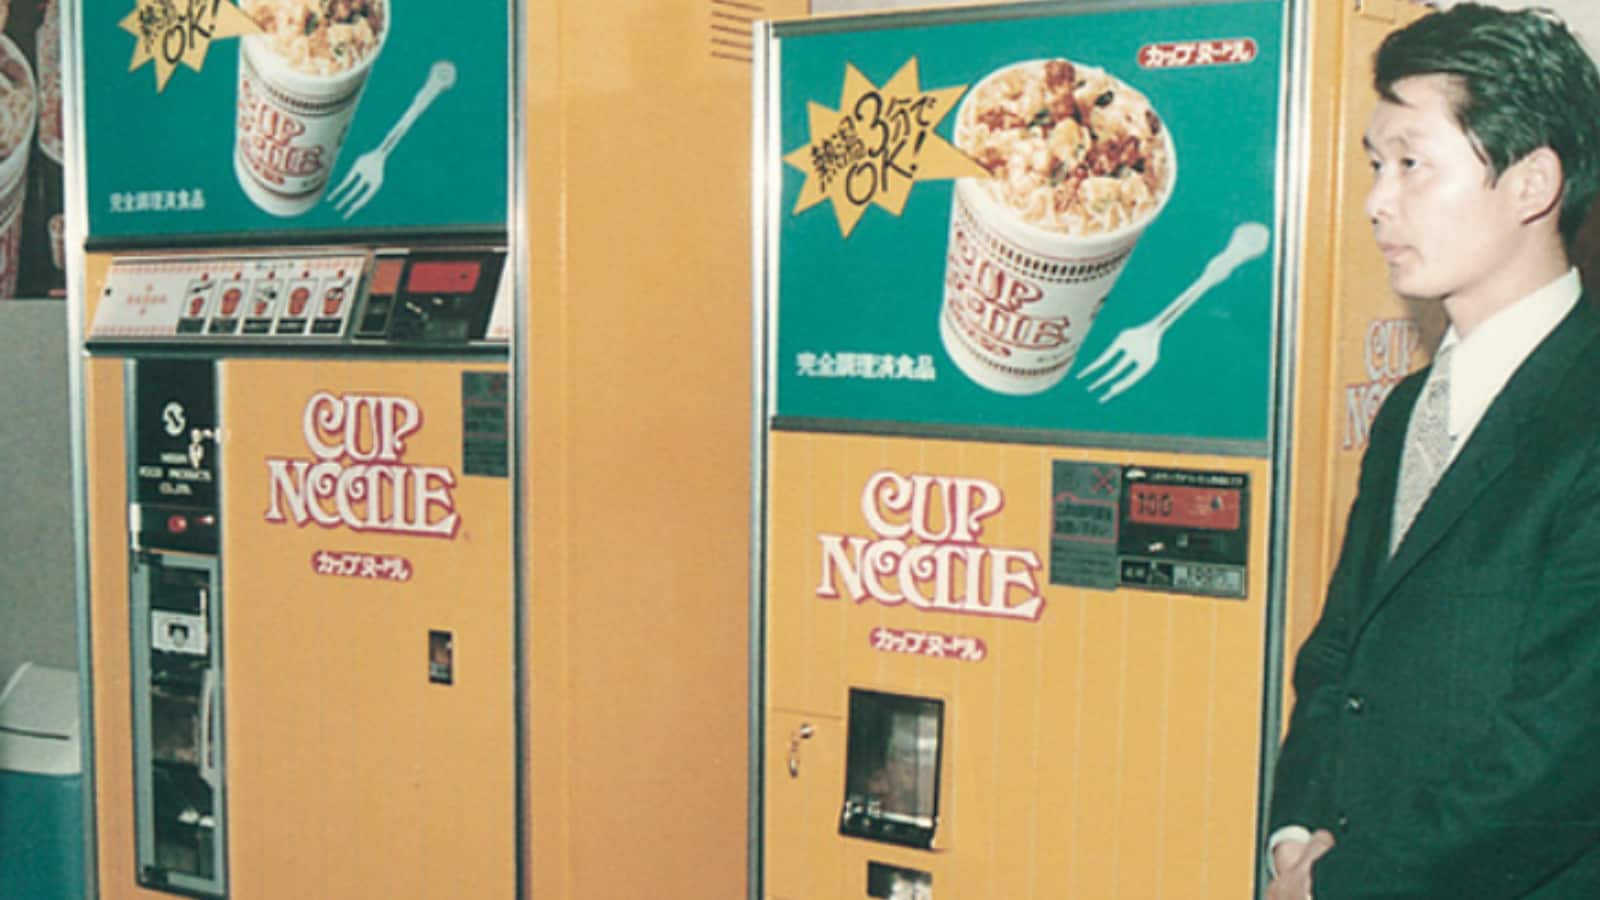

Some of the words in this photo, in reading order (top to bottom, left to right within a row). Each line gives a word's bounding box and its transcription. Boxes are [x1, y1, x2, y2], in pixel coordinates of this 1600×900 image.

[845, 129, 927, 206] OK!
[303, 389, 423, 463] CUP
[264, 456, 462, 540] NOODLE
[861, 469, 1006, 544] CUP
[815, 532, 1045, 622] NOODLE
